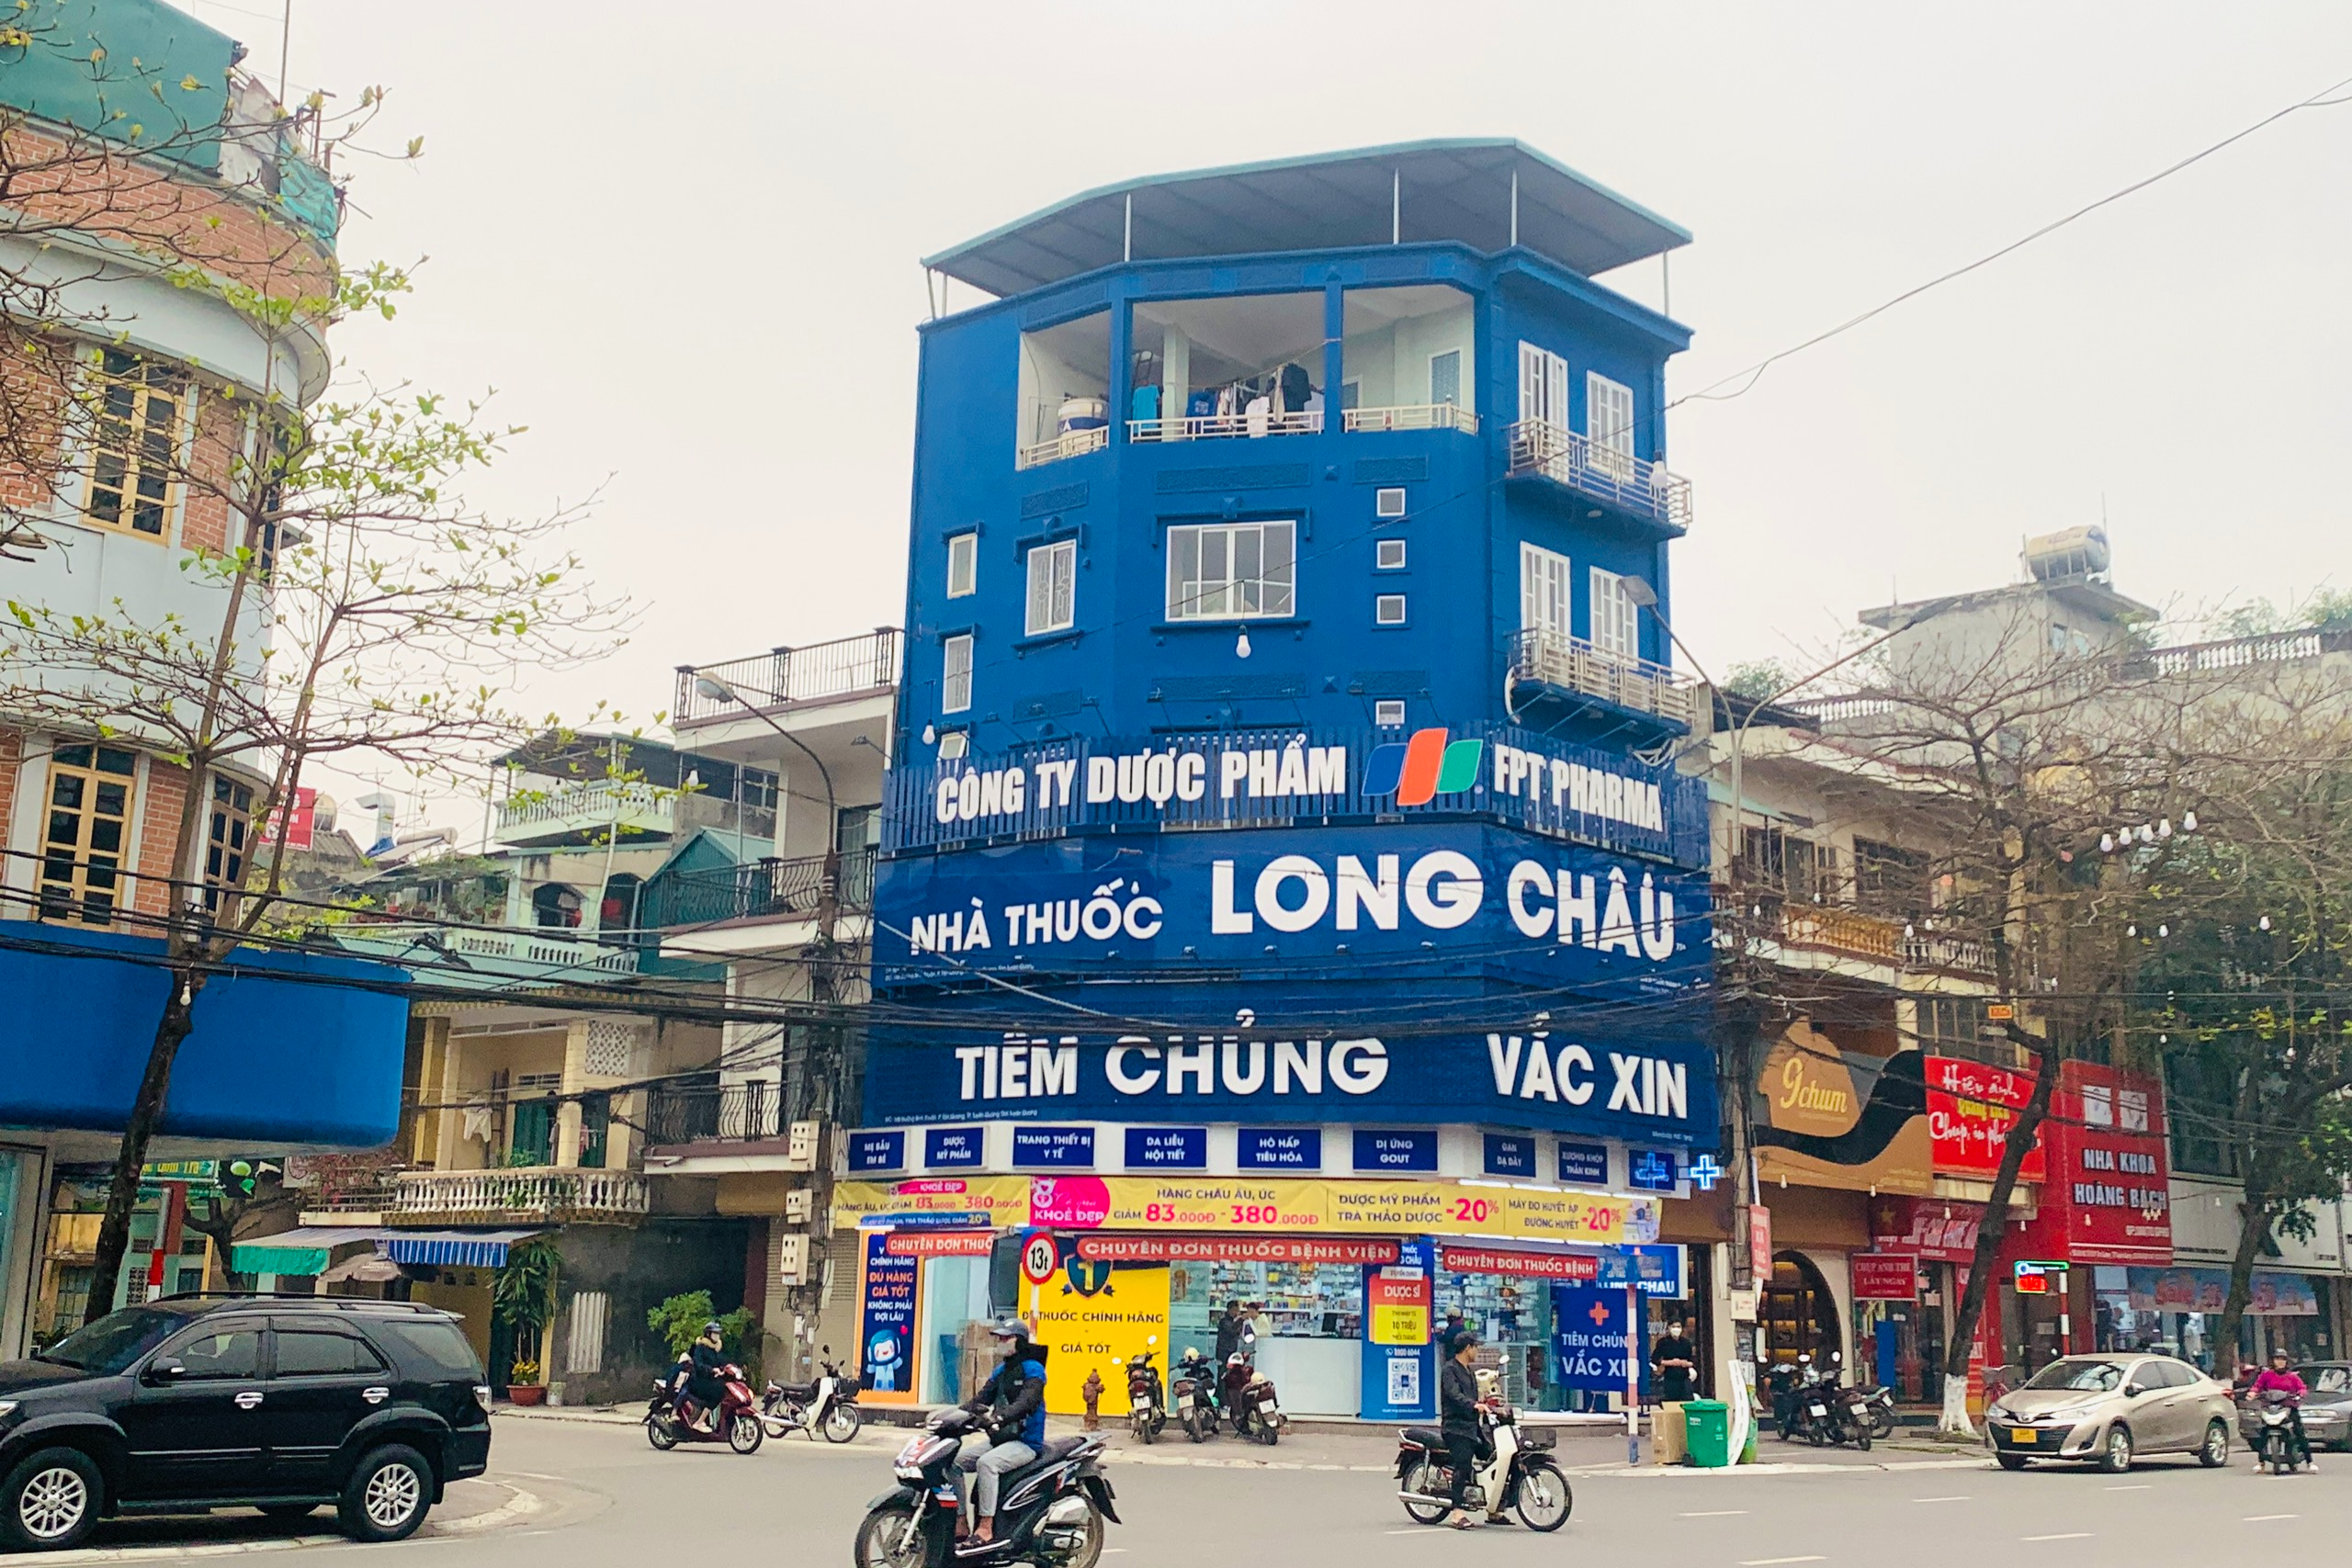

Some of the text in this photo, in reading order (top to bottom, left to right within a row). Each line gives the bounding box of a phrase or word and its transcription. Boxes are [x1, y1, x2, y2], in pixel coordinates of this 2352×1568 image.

[936, 733, 1664, 831] CÔNG TY DƯỢC PHẨM FPT PHARMA
[910, 897, 991, 955] NHÀ
[1004, 877, 1164, 947] THUỐC
[1211, 850, 1485, 934] LONG
[1507, 859, 1675, 961] CHÂU
[955, 1008, 1688, 1120] TIÊM CHỦNG VẮC XIN
[943, 1136, 966, 1148] DƯỢC
[1016, 1132, 1091, 1147] TRANG THIẾT BỊ
[1147, 1136, 1161, 1146] DA
[1260, 1135, 1300, 1148] HÔ HẤP
[1376, 1139, 1388, 1151] DỊ
[1044, 1146, 1065, 1159] Y TẾ
[1145, 1148, 1185, 1164] NỘI TIẾT
[1255, 1150, 1303, 1163] TIÊU HÓA
[1380, 1153, 1410, 1164] GOUT
[2083, 1148, 2157, 1175] NHA KHOA
[1157, 1188, 1193, 1200] HÀNG
[1196, 1187, 1232, 1200] CHÂU
[1260, 1187, 1276, 1200] ÚC
[1339, 1194, 1377, 1207] DƯỢC
[1379, 1193, 1399, 1205] MỸ
[1402, 1192, 1442, 1206] PHẨM
[1509, 1197, 1526, 1210] MÁY
[1076, 1209, 1105, 1224] ĐẸP
[1114, 1207, 1142, 1219] GIẢM
[1338, 1208, 1443, 1224] TRÀ THẢO DƯỢC
[890, 1235, 934, 1251] CHUYÊN
[935, 1237, 961, 1251] ĐƠN
[1084, 1239, 1391, 1261] CHUYÊN ĐƠN THUỐC BỆNH VIỆN
[870, 1256, 893, 1267] CHÍNH
[1030, 1247, 1049, 1271] 13t
[1447, 1252, 1594, 1278] CHUYÊN ĐƠN THUỐC BỆNH
[869, 1268, 913, 1283] ĐỦ HÀNG
[872, 1282, 910, 1298] GIÁ TỐT
[1385, 1285, 1412, 1301] DƯỢC
[867, 1299, 894, 1310] KHÔNG
[1039, 1308, 1079, 1322] THUỐC
[1082, 1309, 1124, 1323] CHÍNH
[1126, 1310, 1164, 1324] HÃNG
[1561, 1330, 1639, 1348] TIÊM CHỦN
[1061, 1340, 1112, 1354] GIÁ TỐT
[1562, 1348, 1603, 1376] VẮC
